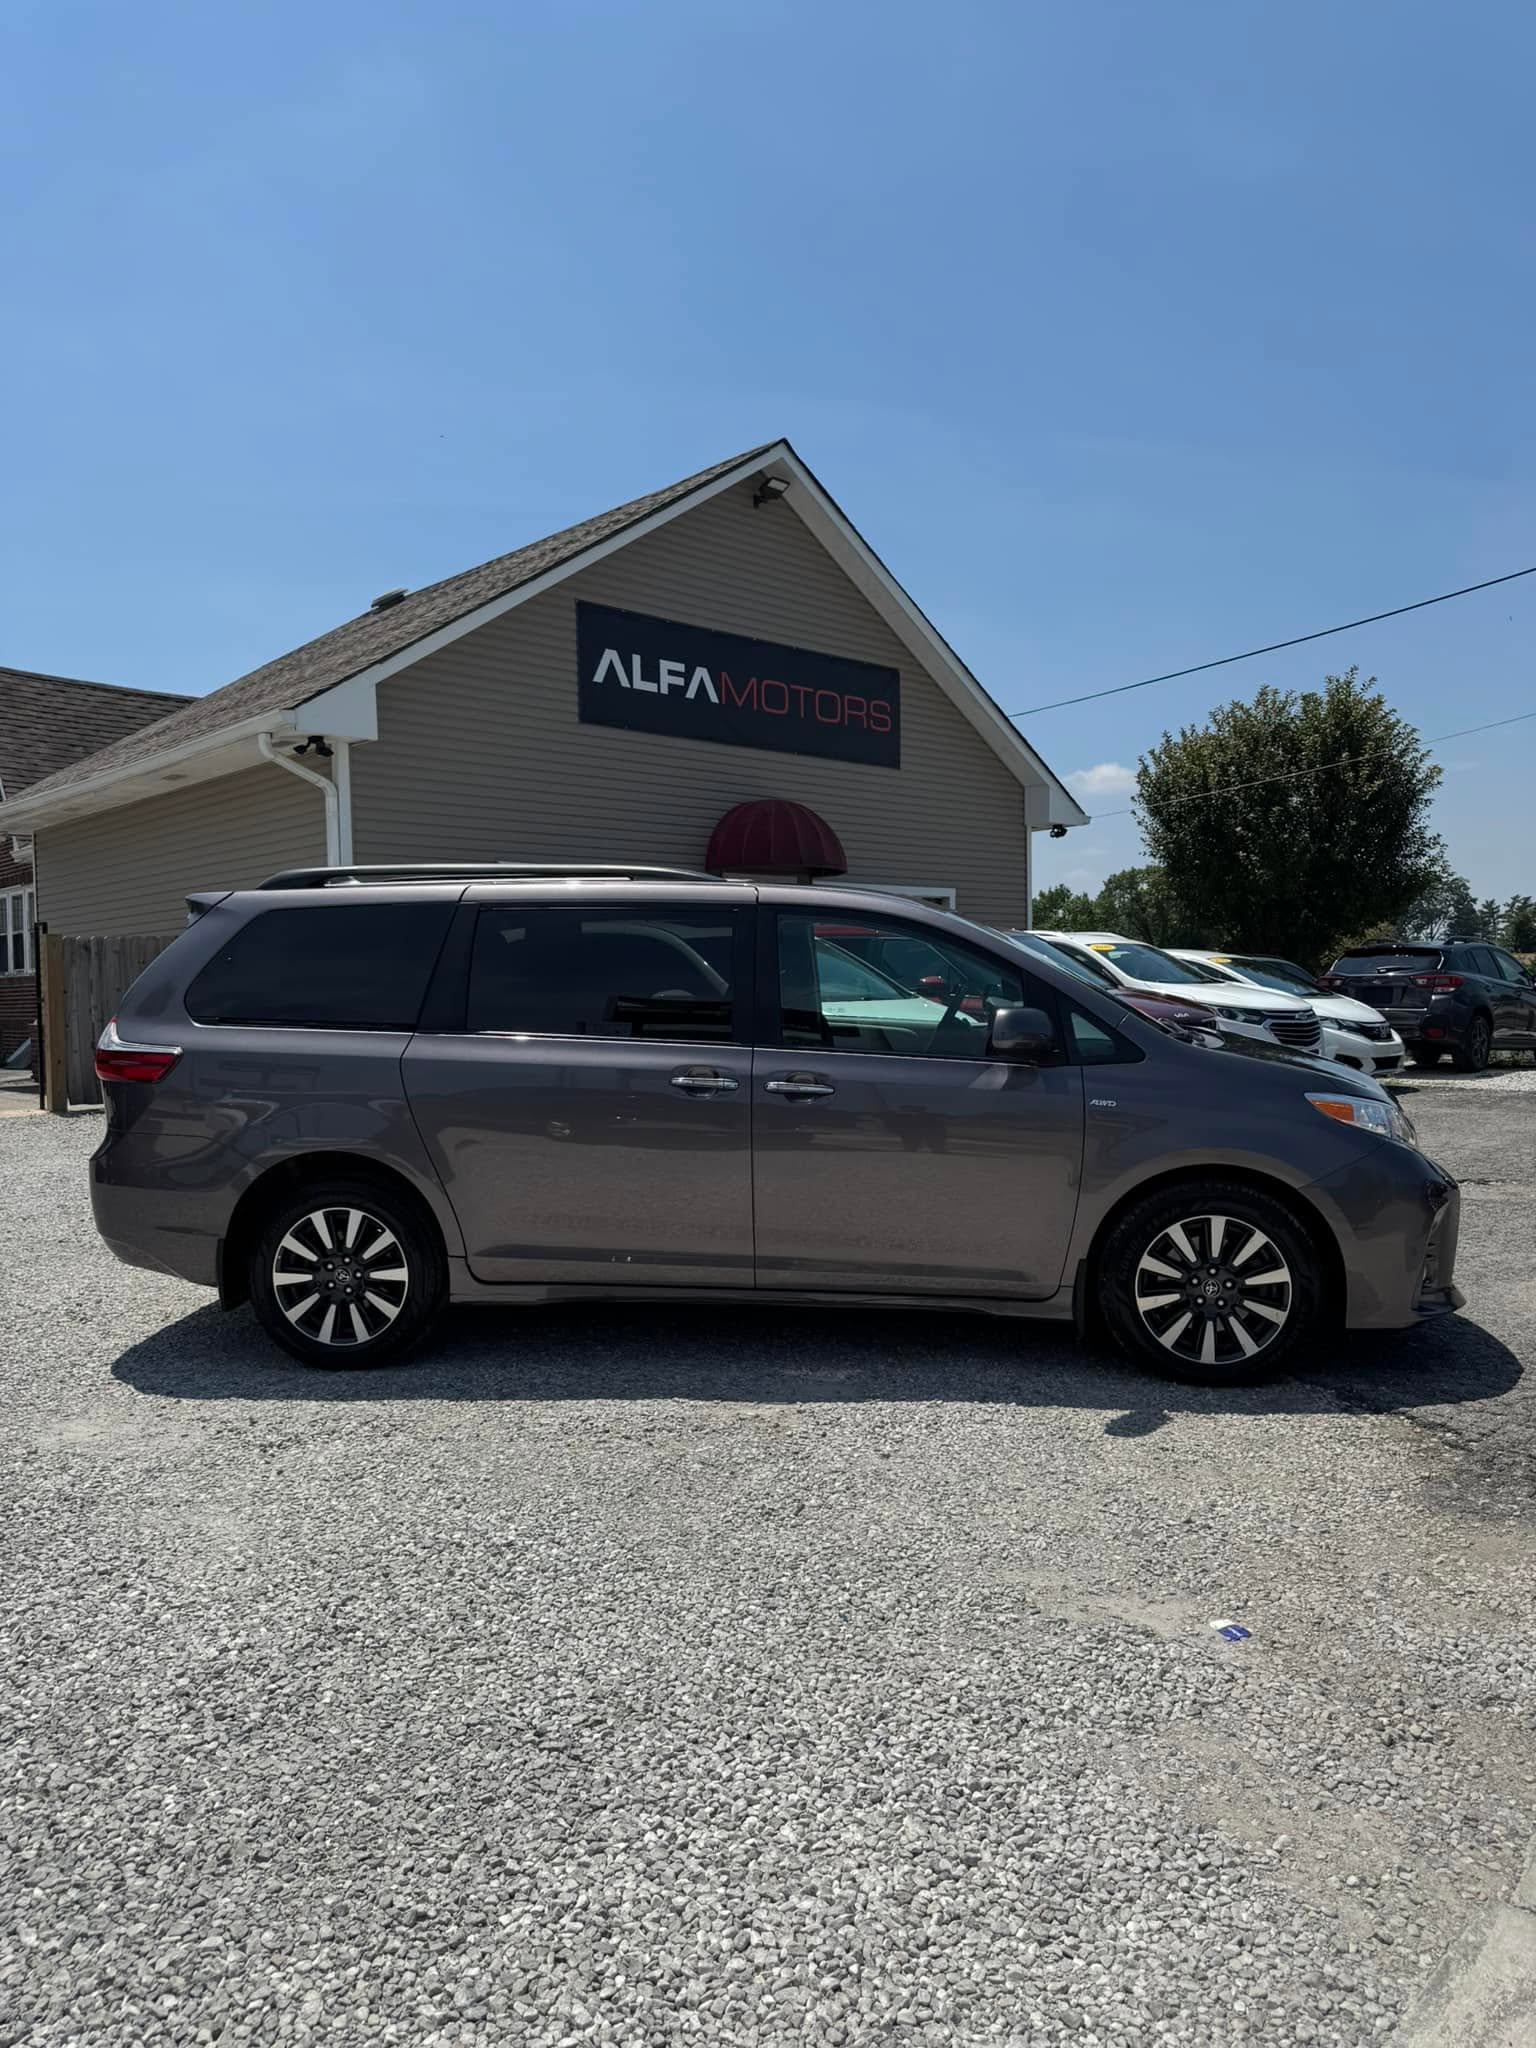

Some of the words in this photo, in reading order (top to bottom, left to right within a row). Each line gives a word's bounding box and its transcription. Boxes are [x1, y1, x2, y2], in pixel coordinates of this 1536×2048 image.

[592, 648, 720, 704] ALFA
[721, 671, 892, 733] MOTORS
[1089, 1099, 1117, 1107] AWD
